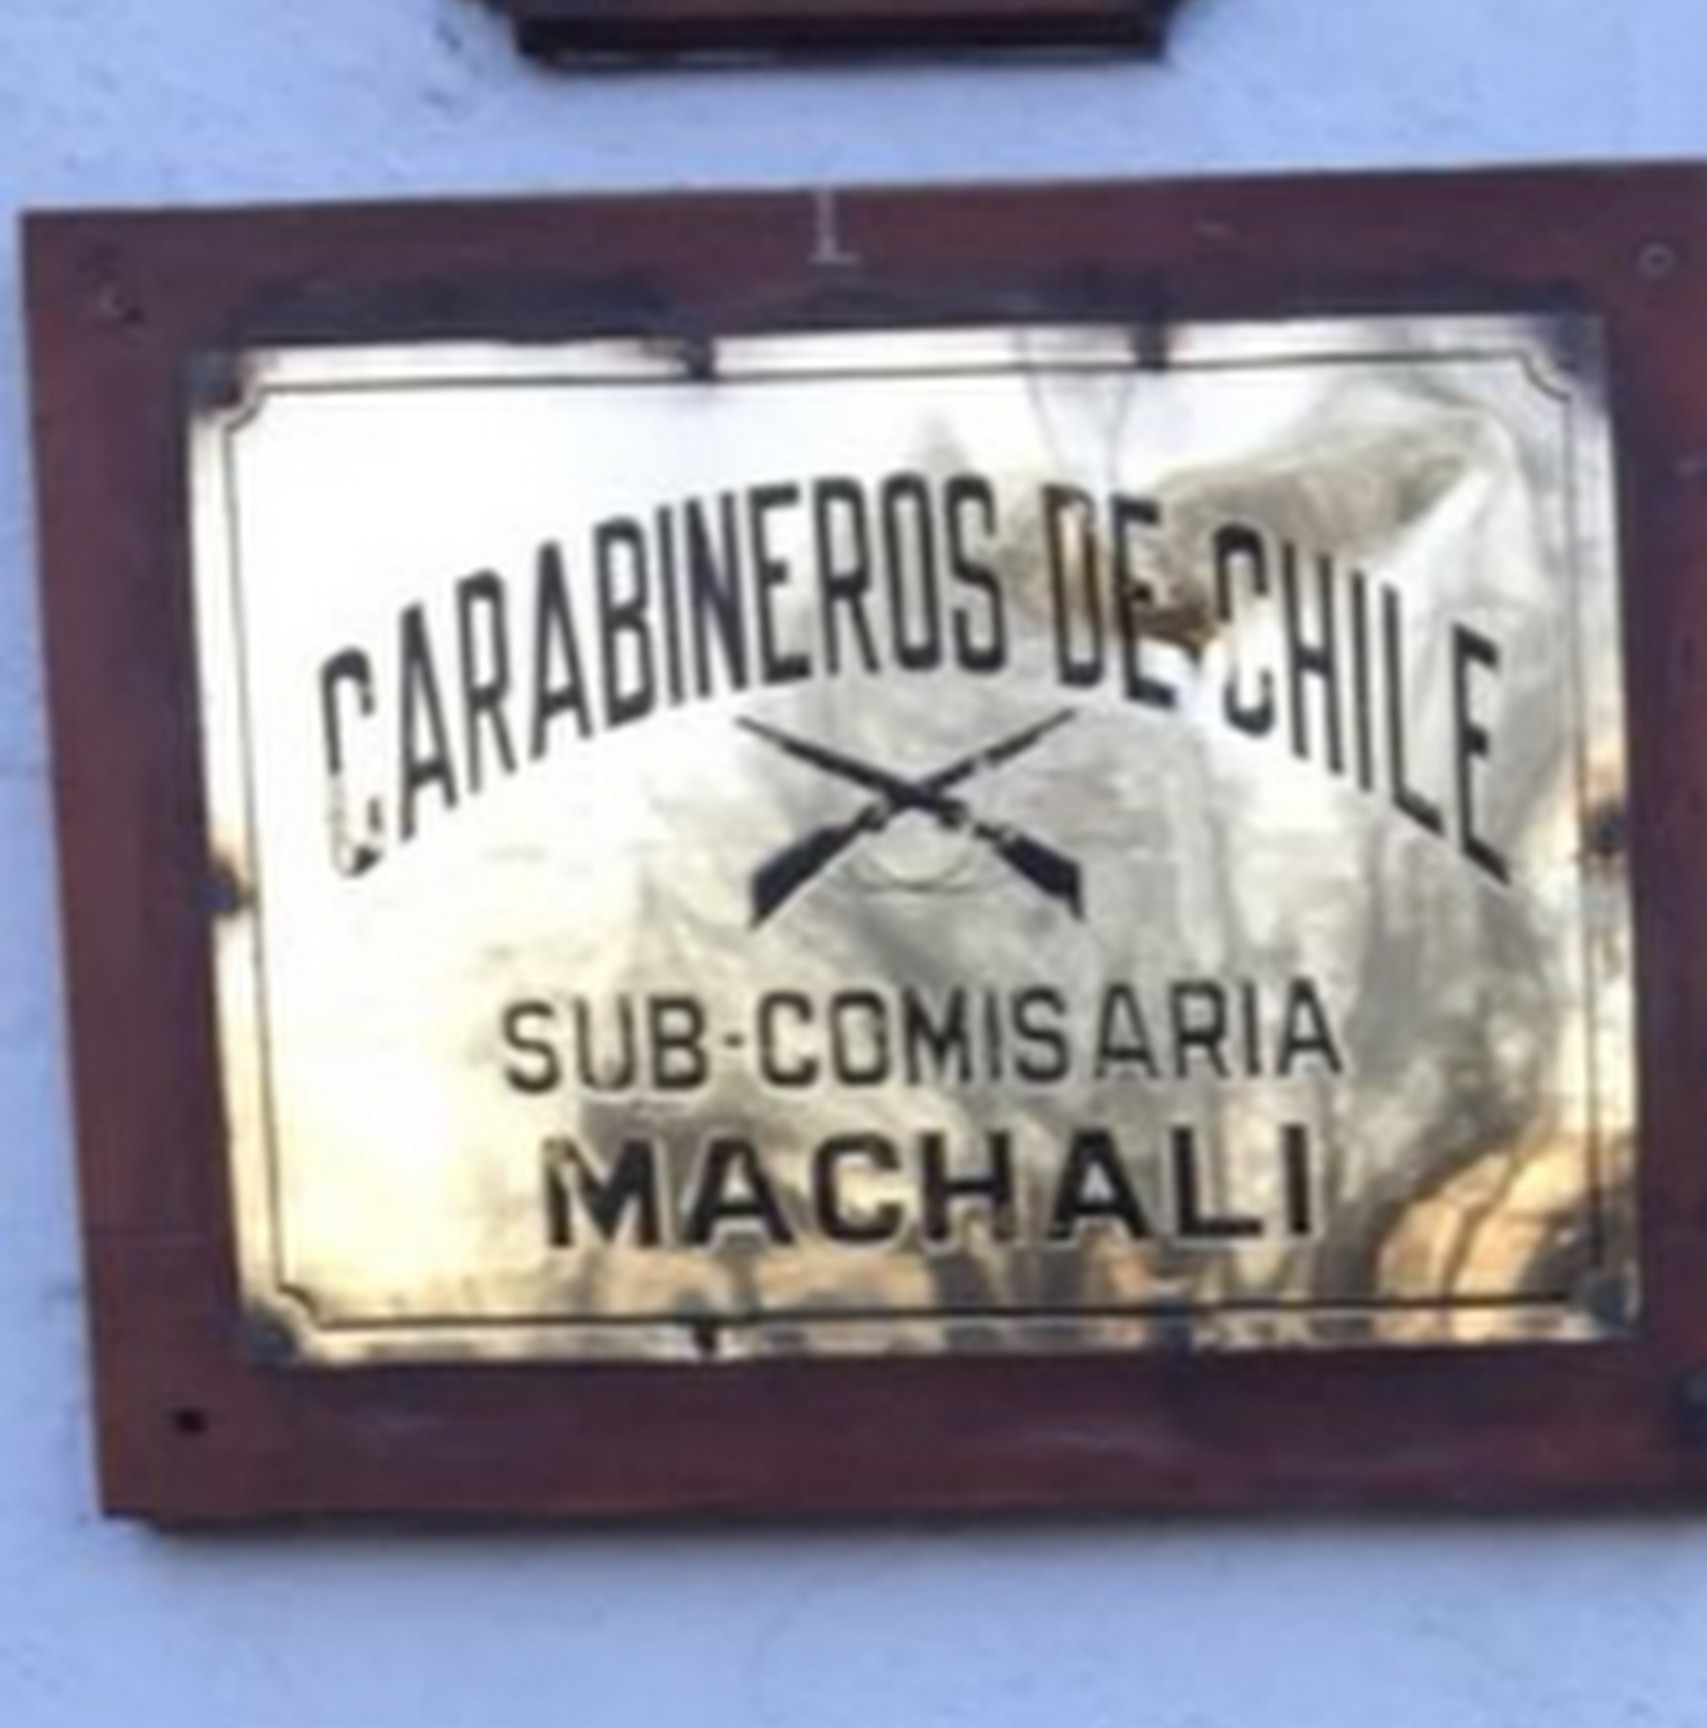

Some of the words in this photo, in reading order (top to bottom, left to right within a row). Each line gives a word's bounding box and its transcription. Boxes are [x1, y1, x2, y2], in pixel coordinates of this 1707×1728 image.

[320, 472, 1008, 878] CARABINEROS
[1040, 482, 1178, 708] DE
[1210, 520, 1512, 886] CHILE
[502, 978, 1344, 1096] SUB-COMISARIA
[541, 1122, 1312, 1248] MACHALI
